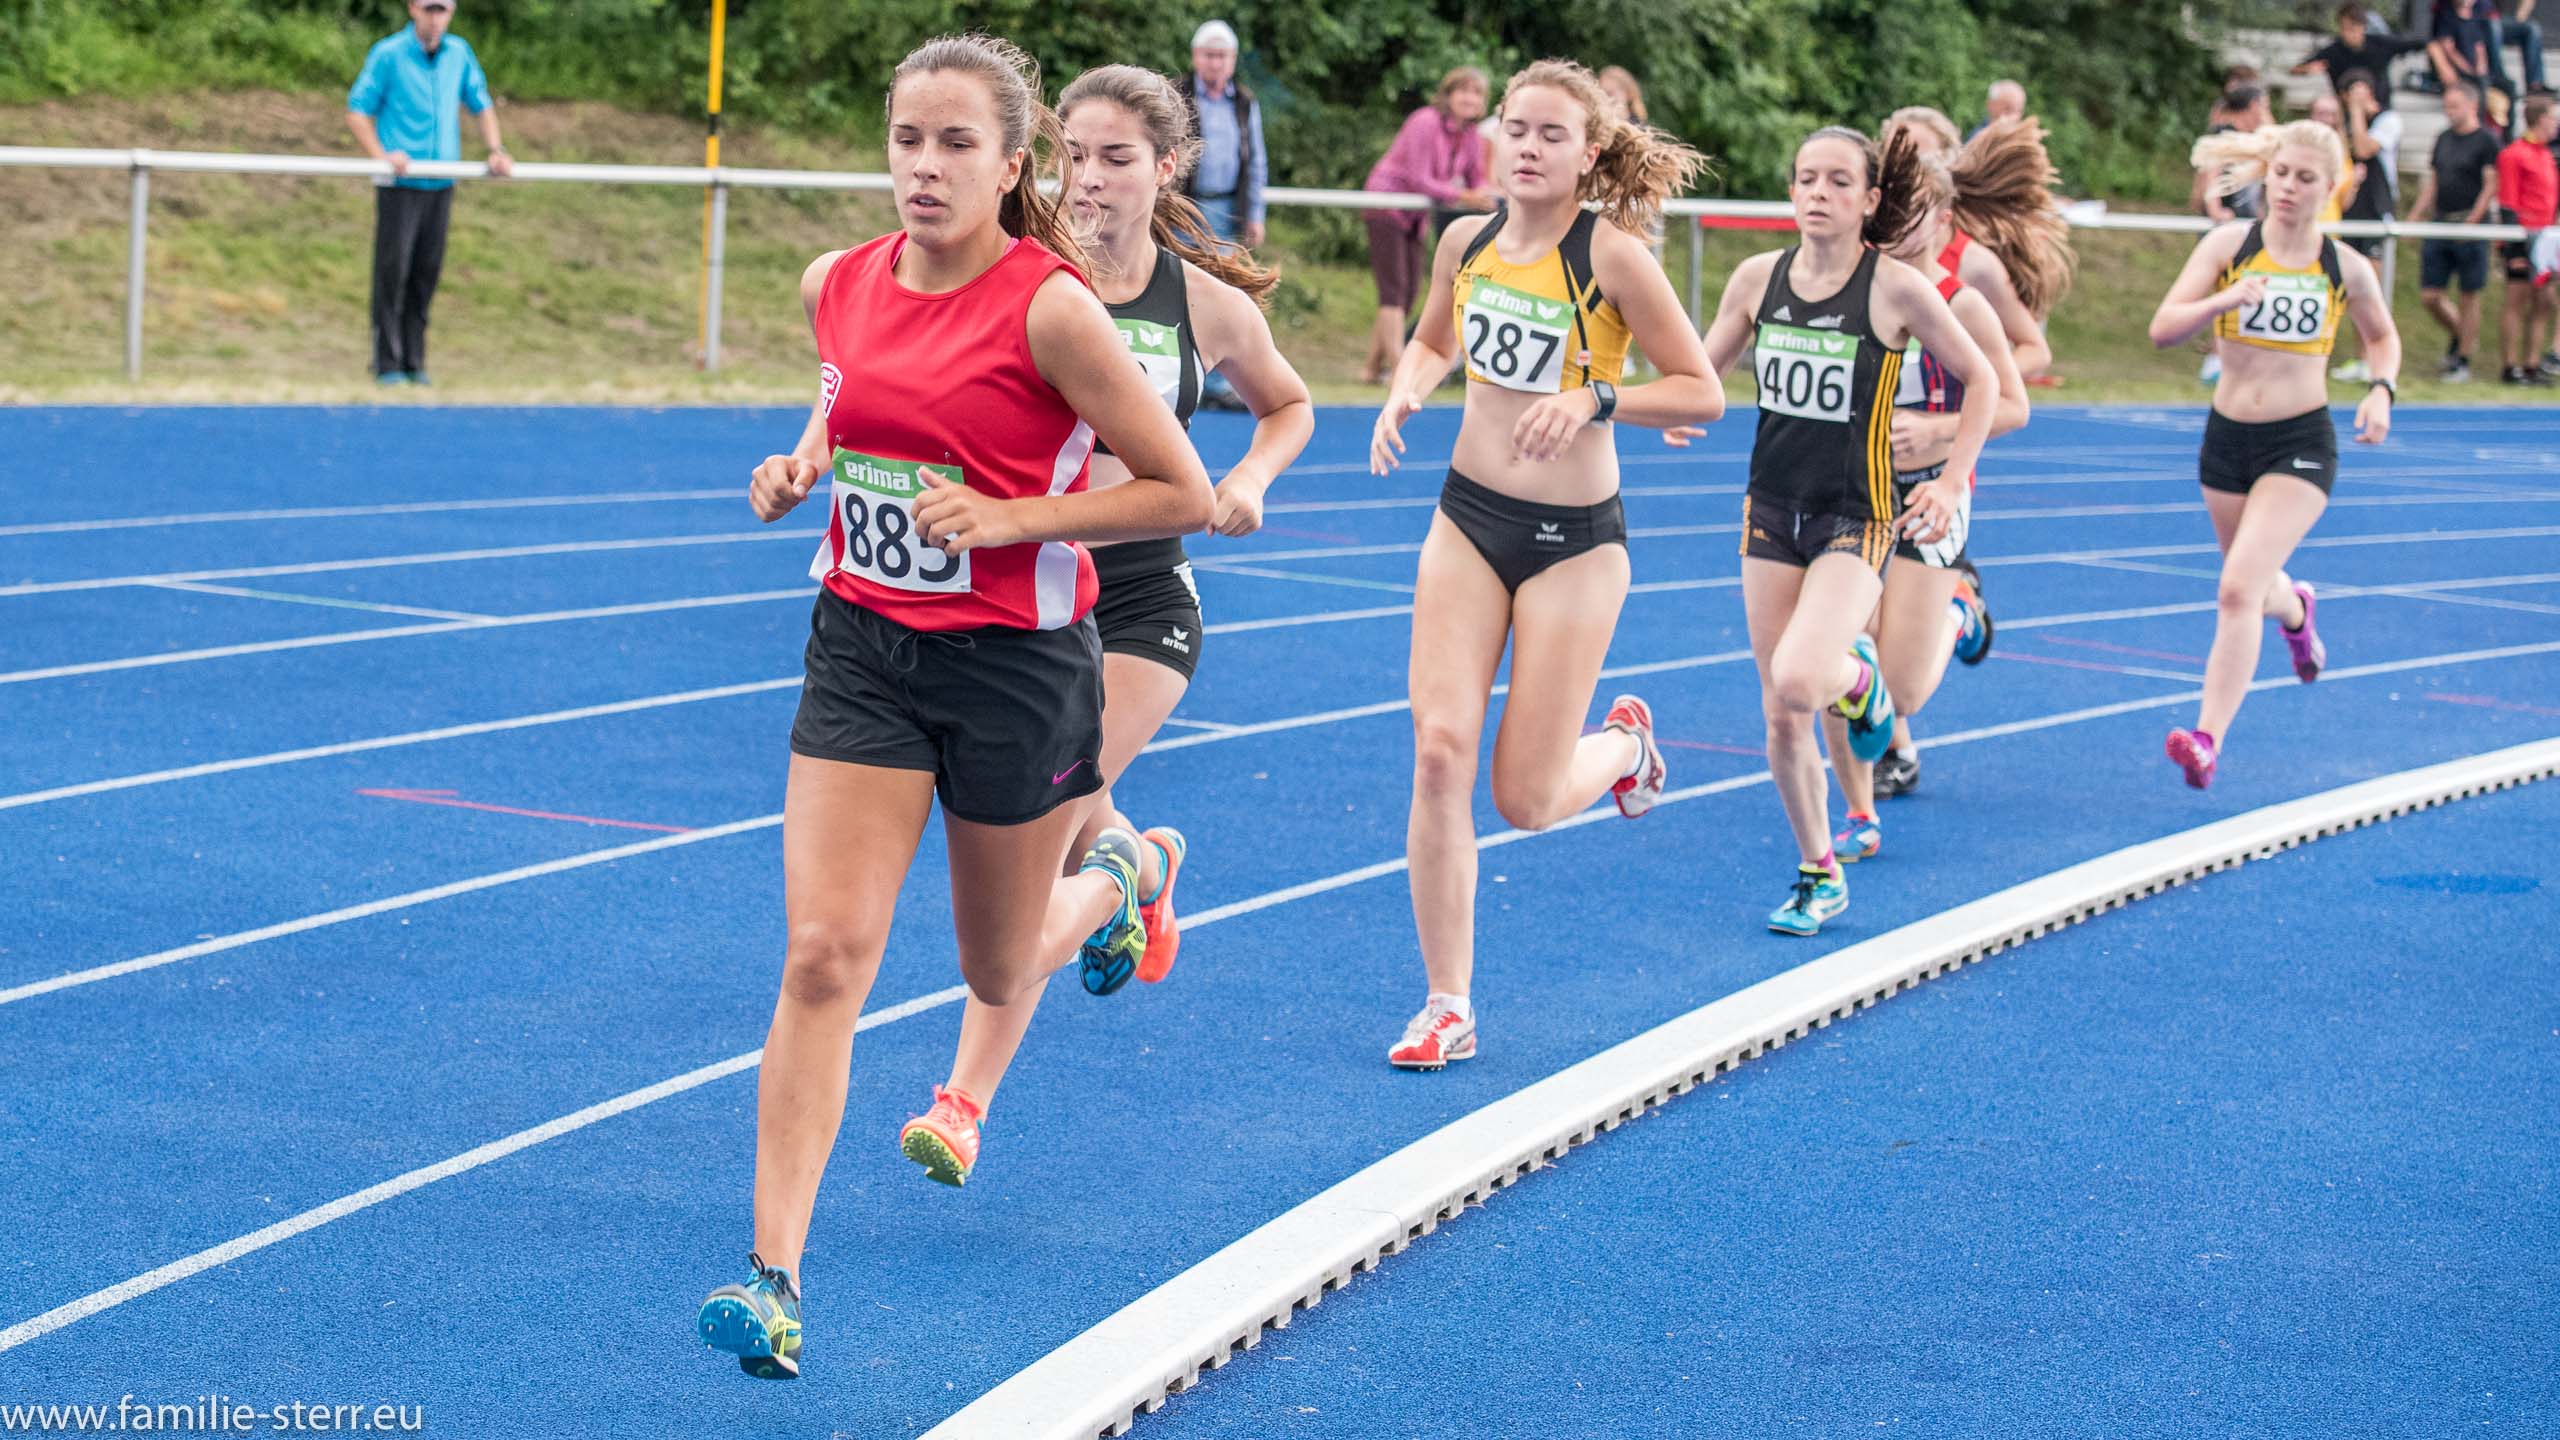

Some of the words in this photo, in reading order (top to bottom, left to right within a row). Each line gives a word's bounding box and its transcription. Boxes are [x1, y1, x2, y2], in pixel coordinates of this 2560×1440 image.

[1479, 286, 1532, 316] erima
[2245, 296, 2319, 334] 288
[1468, 313, 1561, 383] 287
[1767, 332, 1820, 352] erima
[1764, 357, 1845, 412] 406
[844, 461, 912, 491] erima
[1535, 533, 1565, 543] erima
[1162, 636, 1190, 654] erima
